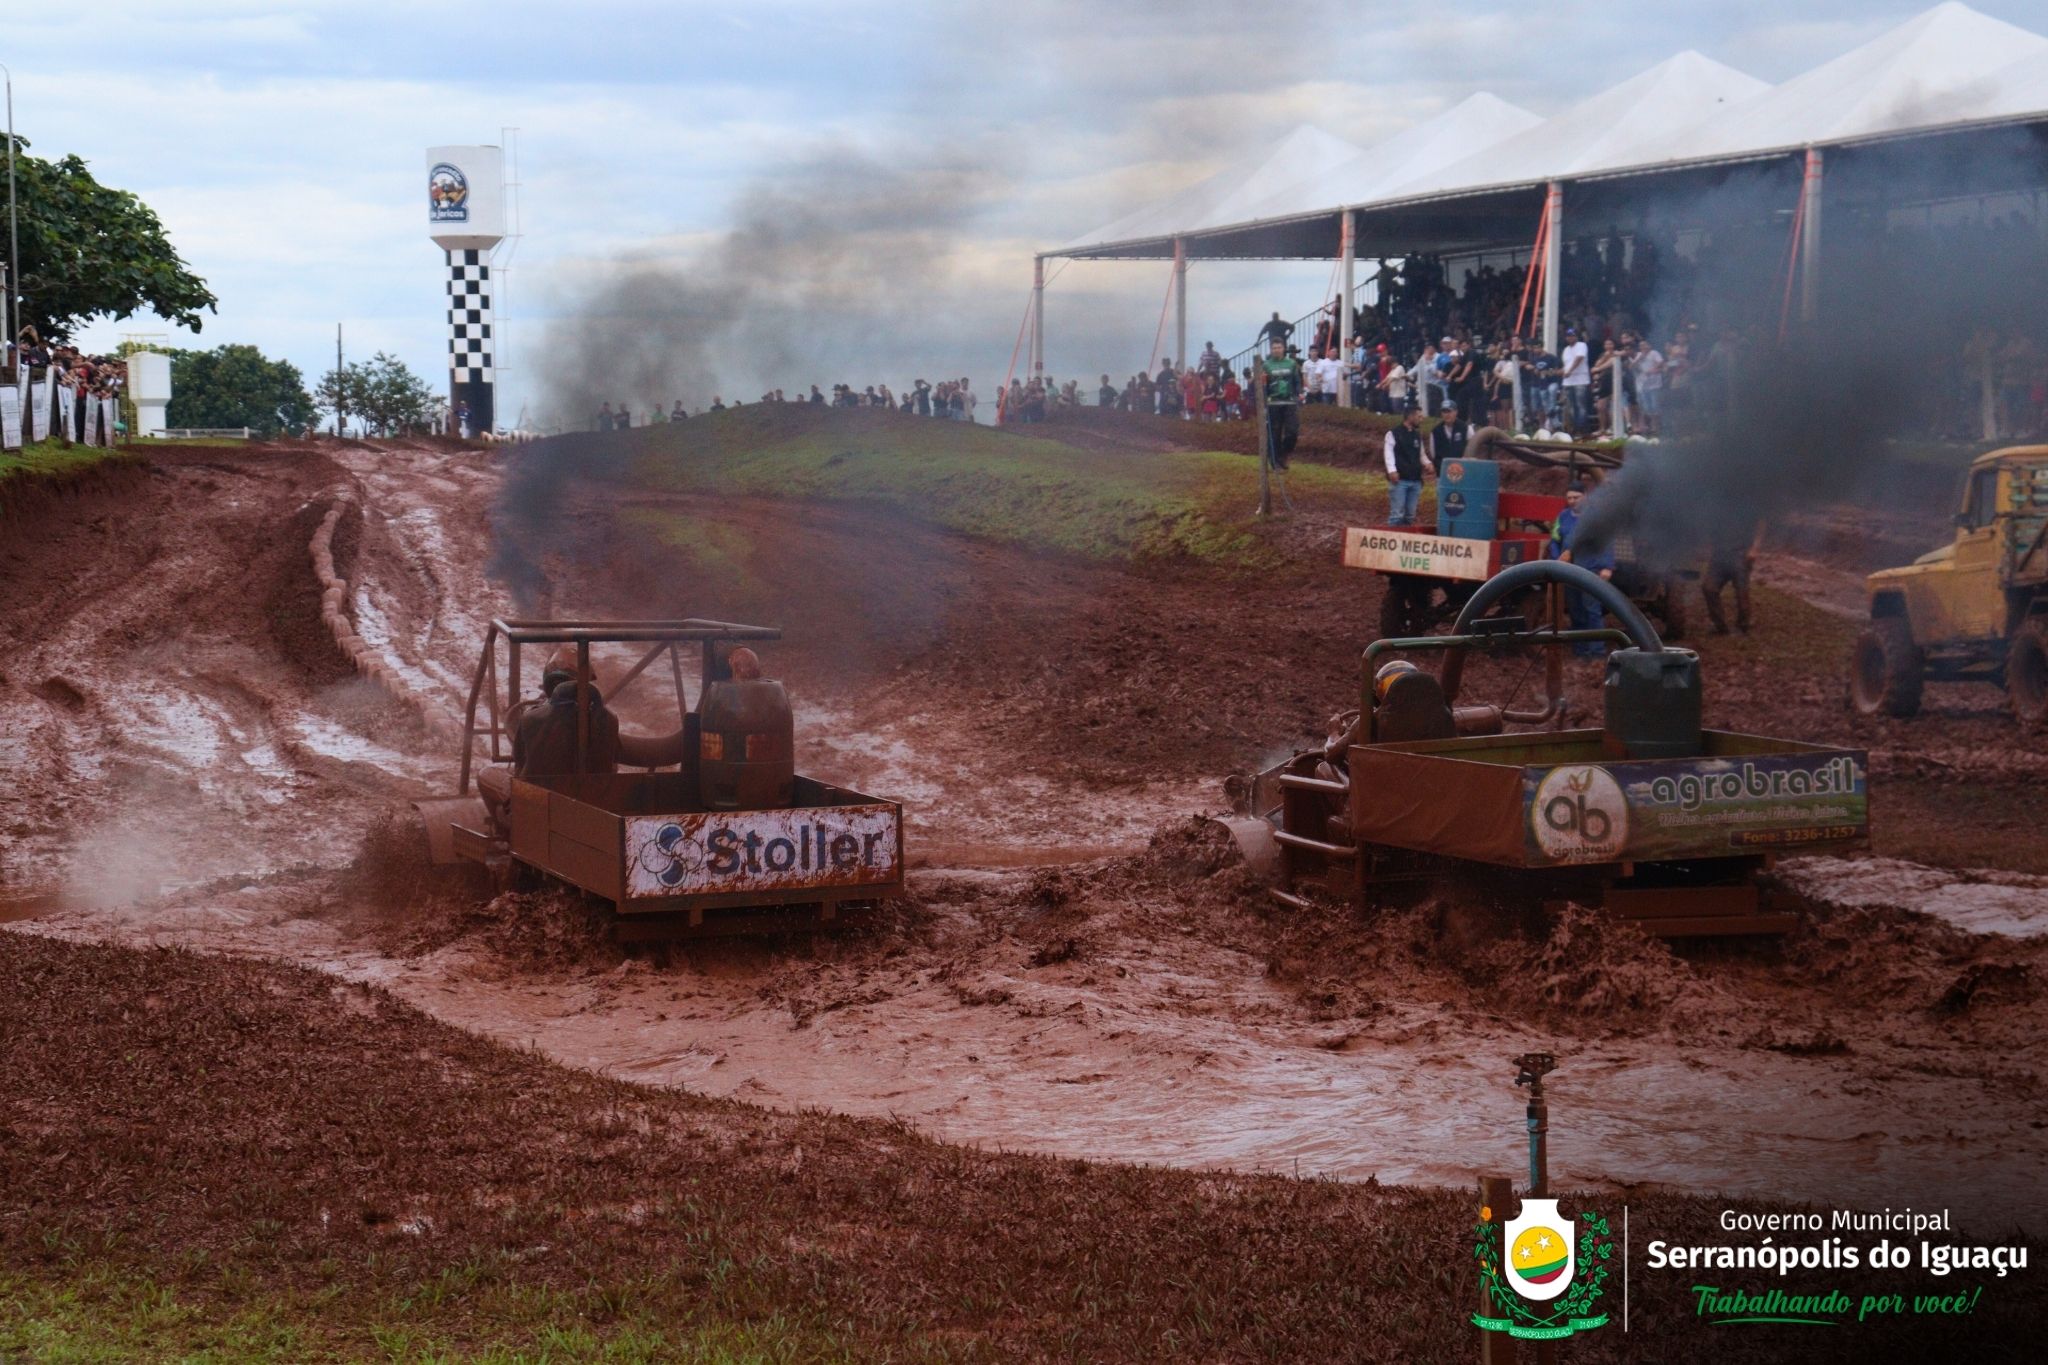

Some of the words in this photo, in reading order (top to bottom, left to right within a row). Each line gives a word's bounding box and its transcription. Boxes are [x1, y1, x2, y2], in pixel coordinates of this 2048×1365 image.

[1360, 536, 1397, 551] AGRO
[1402, 540, 1473, 559] MECÂNICA
[1400, 556, 1430, 570] VIPE
[1651, 757, 1854, 811] agrobrasil
[706, 824, 884, 875] Stoller
